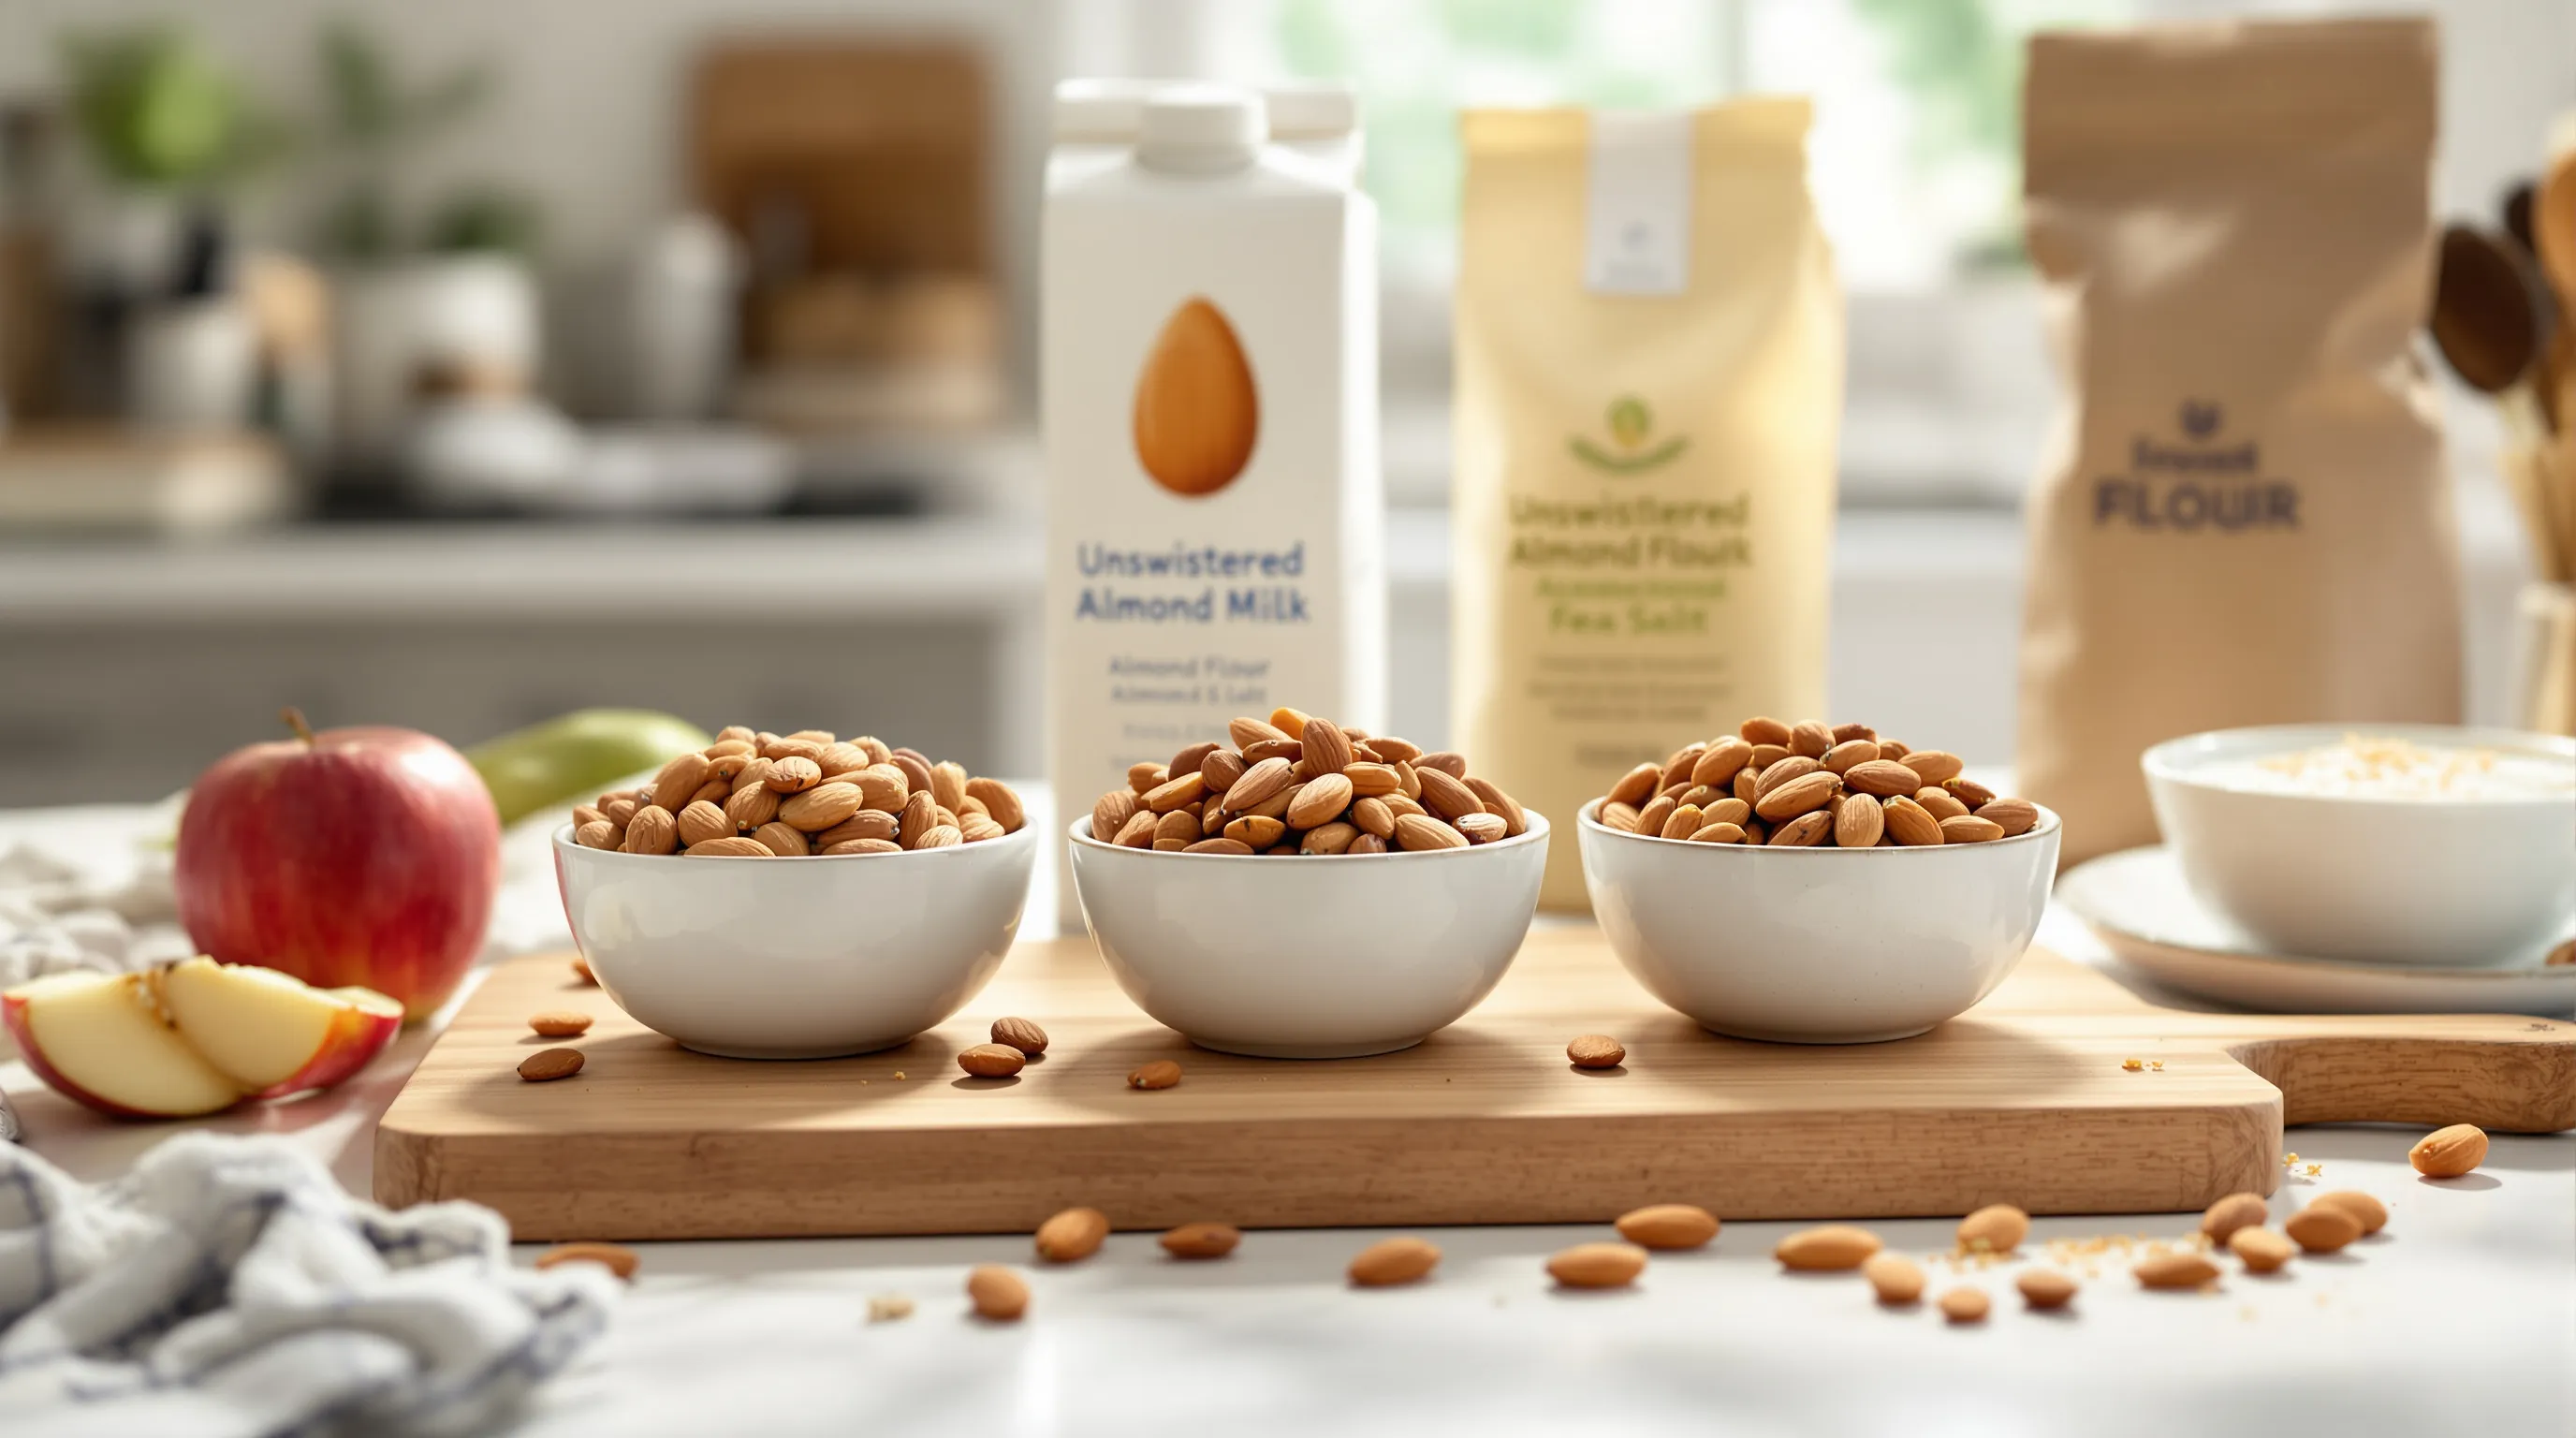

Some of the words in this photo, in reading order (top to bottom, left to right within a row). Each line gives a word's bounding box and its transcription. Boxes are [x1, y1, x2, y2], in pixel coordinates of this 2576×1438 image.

[1078, 541, 1304, 576] Unswistered
[1077, 588, 1212, 620] Almond
[1226, 588, 1309, 620] Milk
